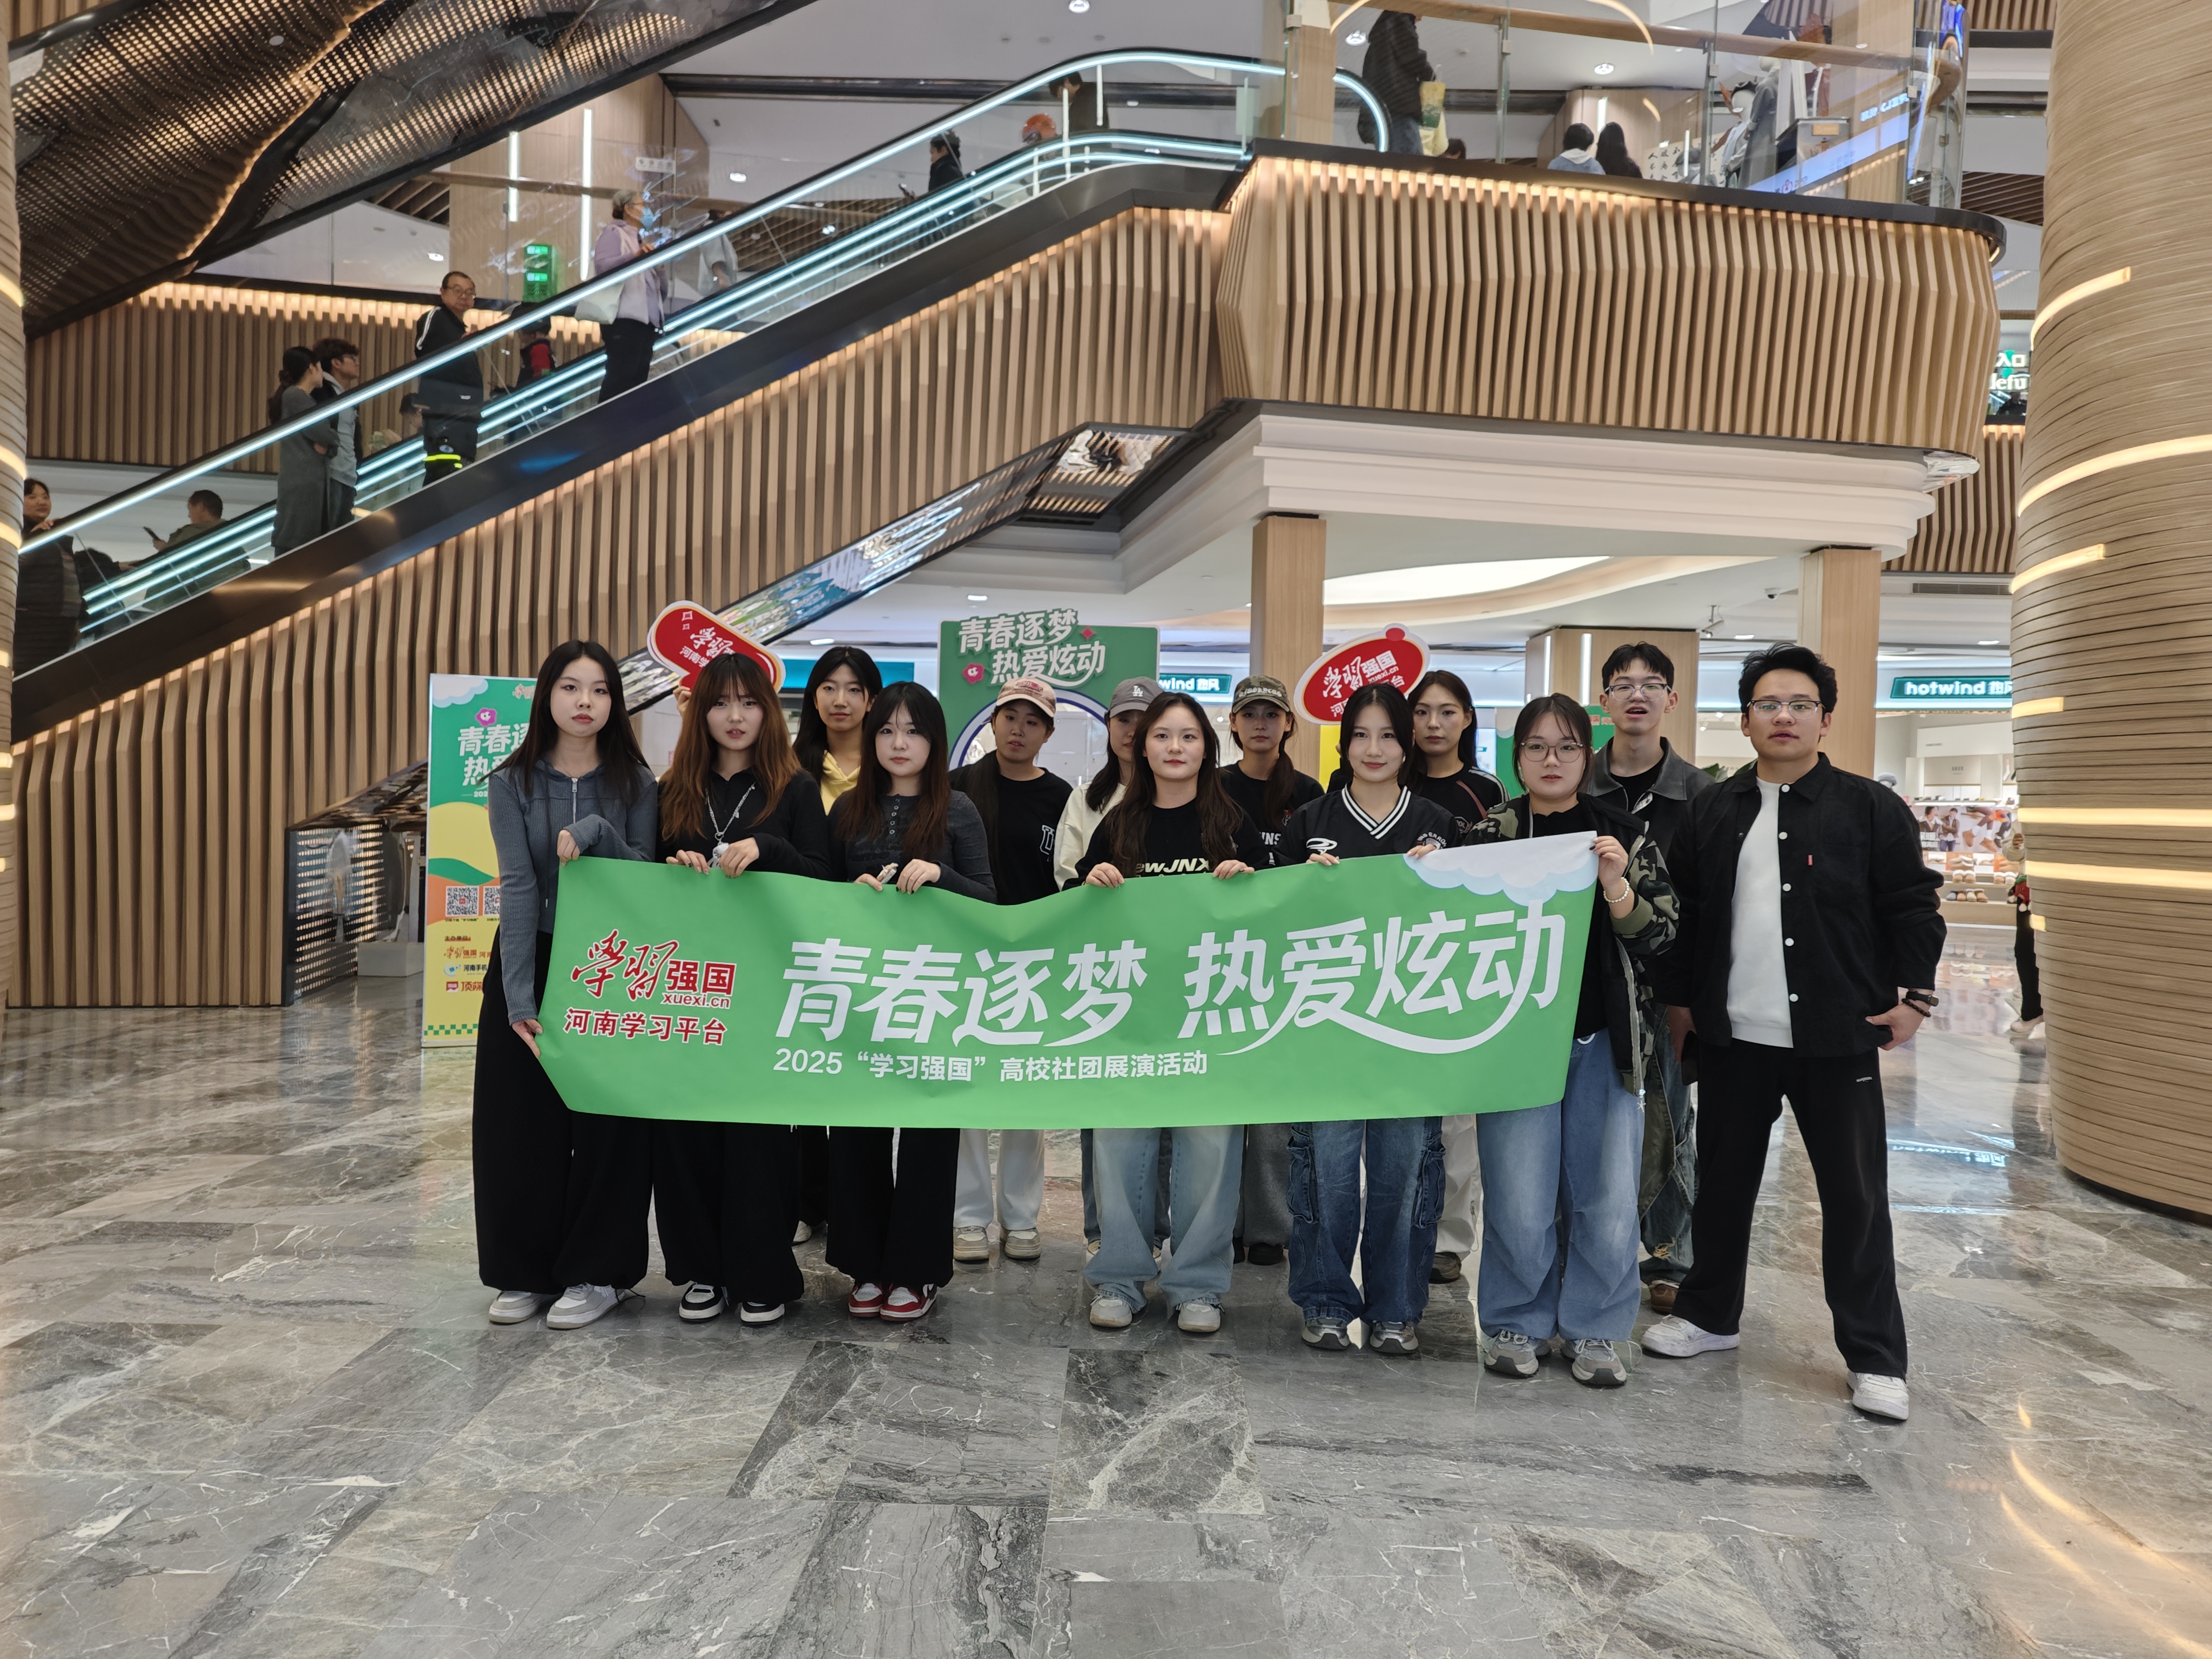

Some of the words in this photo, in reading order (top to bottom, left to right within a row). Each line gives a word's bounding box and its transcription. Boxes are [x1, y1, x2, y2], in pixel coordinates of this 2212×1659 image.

[959, 609, 1076, 653] 青春逐梦
[990, 640, 1106, 687] 热爱炫动
[1905, 681, 1986, 695] hotwind
[775, 938, 1148, 1047] 青春逐梦
[1177, 899, 1566, 1054] 热爱炫动
[662, 992, 731, 1009] xuexi.cn
[563, 1007, 728, 1046] 河南学习平台
